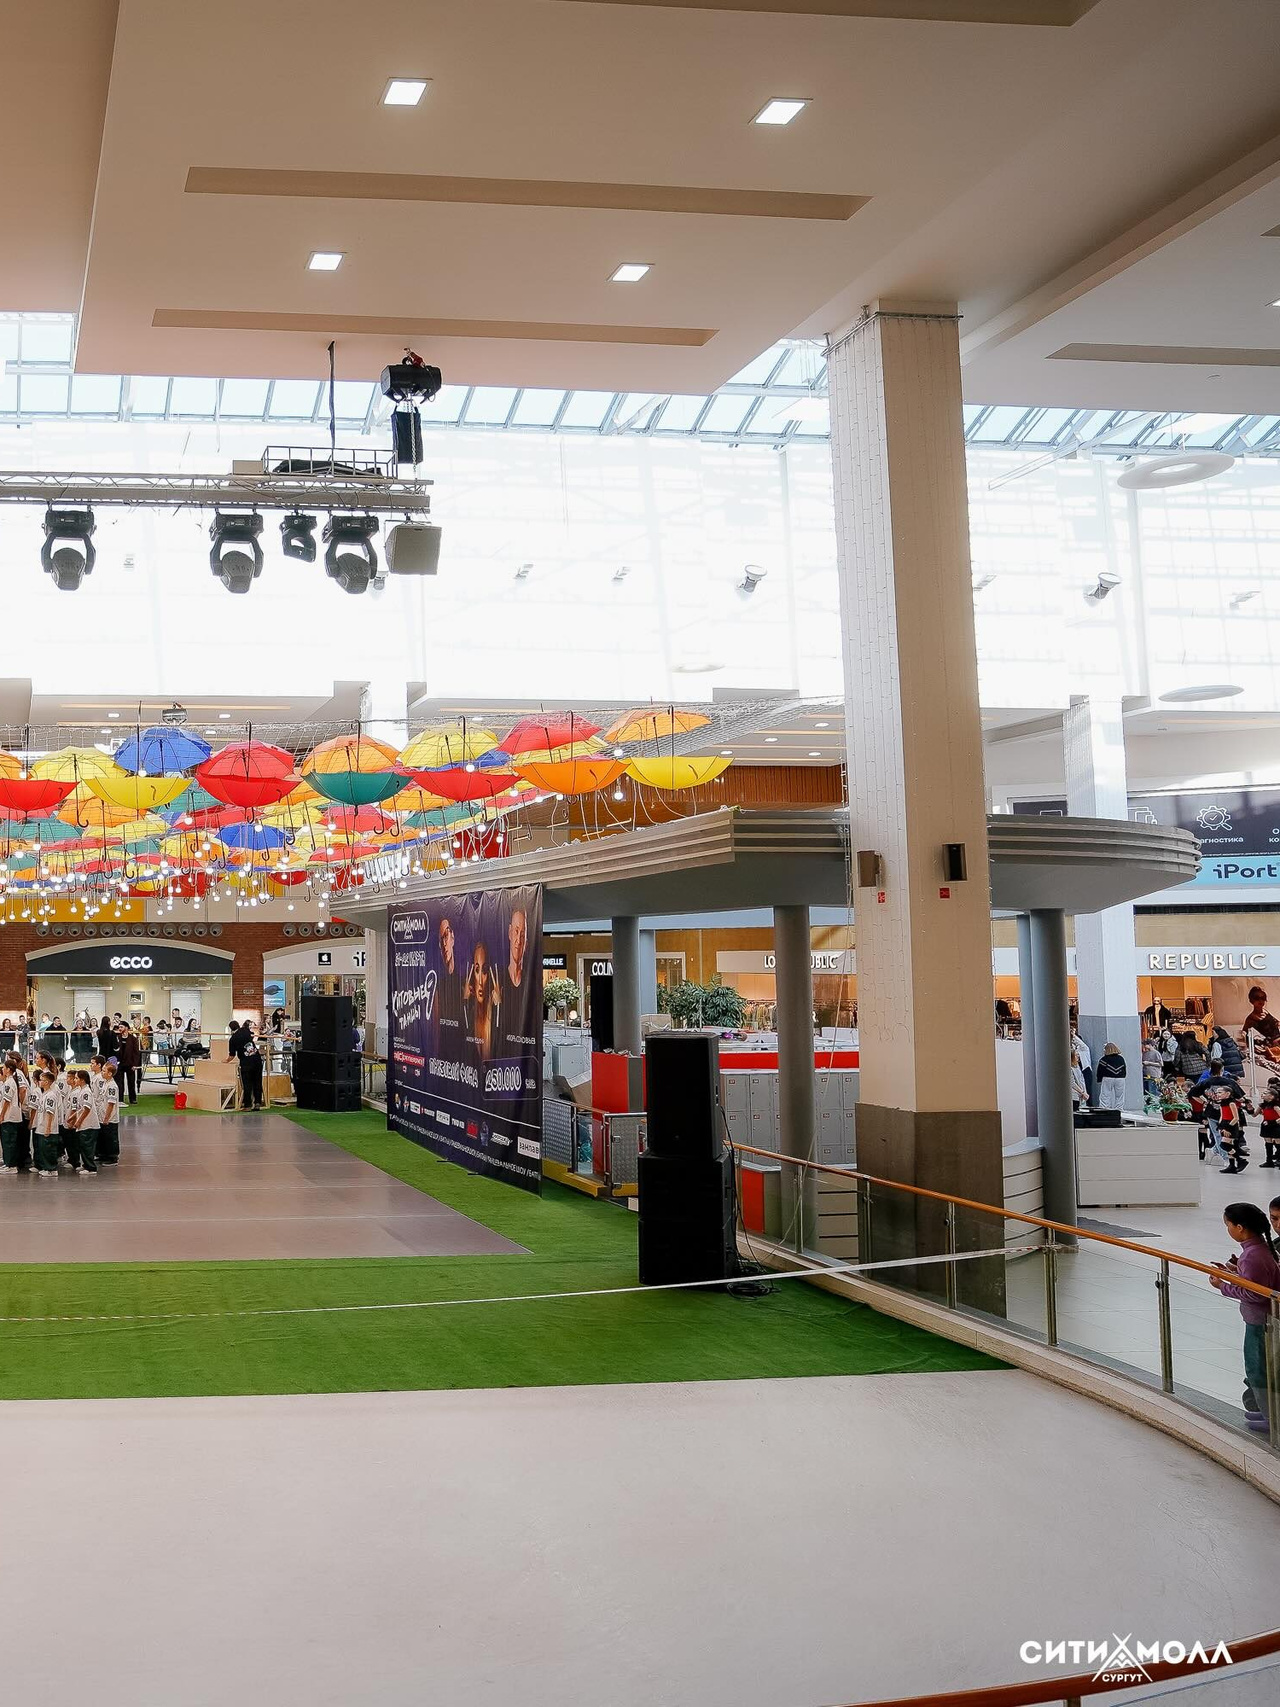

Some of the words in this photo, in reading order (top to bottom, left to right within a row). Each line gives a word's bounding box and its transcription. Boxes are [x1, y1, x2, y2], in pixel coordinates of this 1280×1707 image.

[1213, 863, 1278, 879] iPort
[110, 956, 153, 969] ecco
[1149, 953, 1267, 970] REPUBLIC
